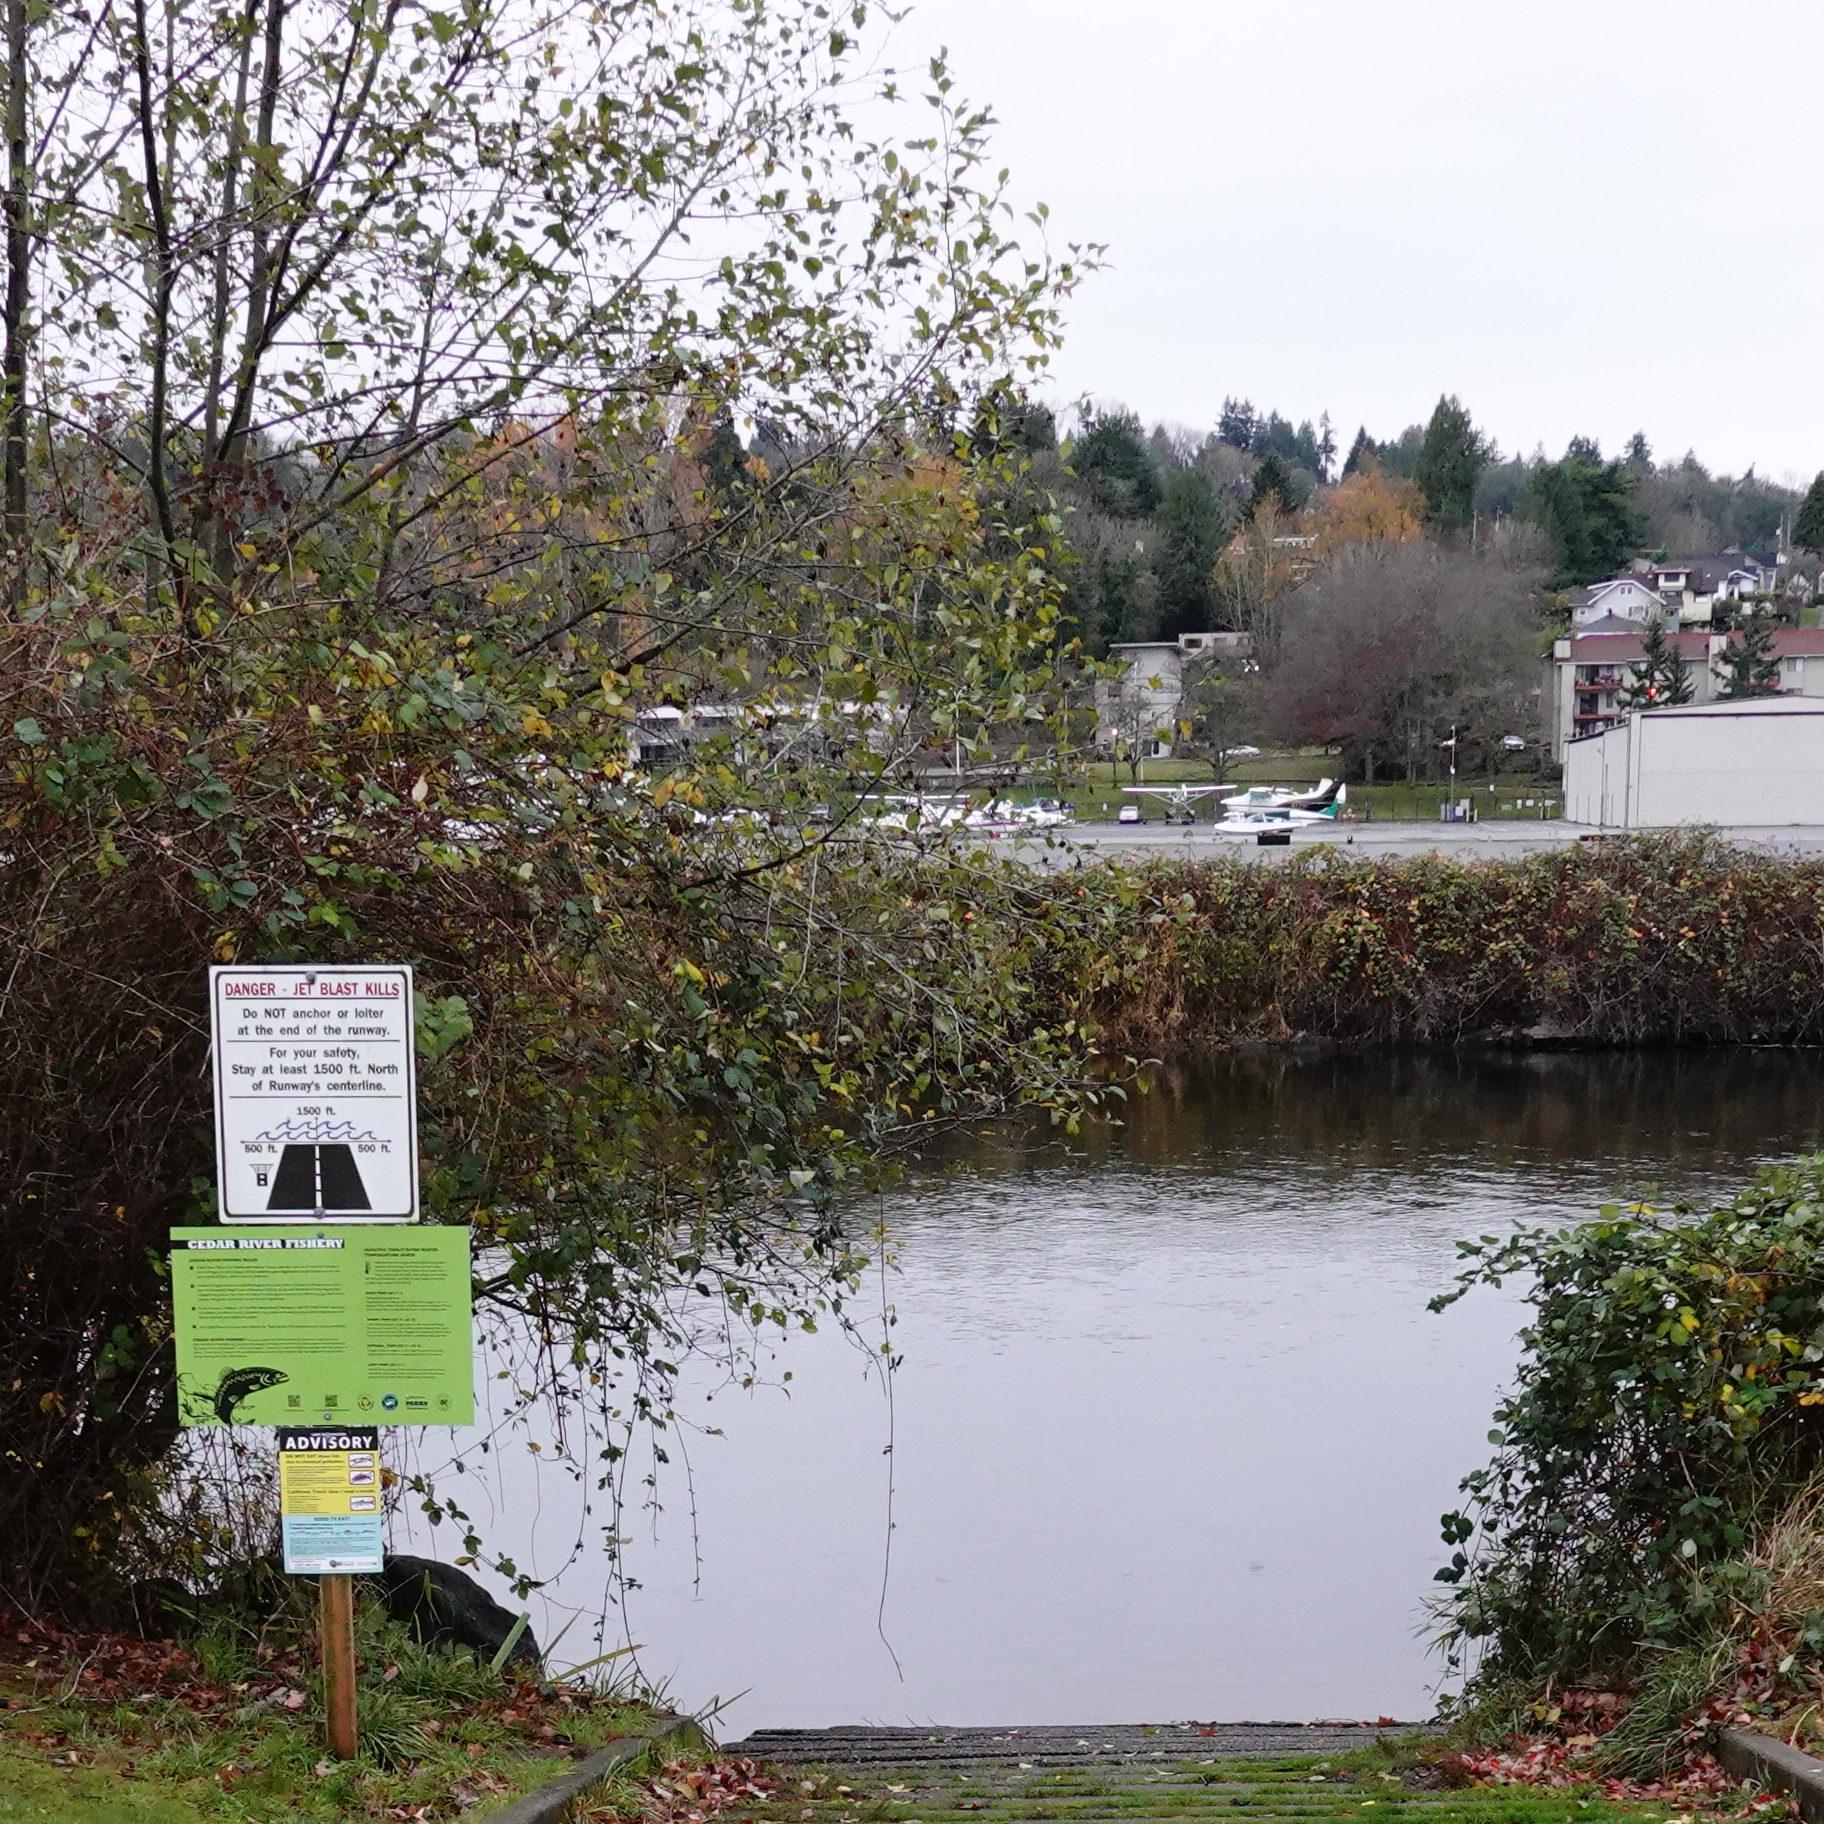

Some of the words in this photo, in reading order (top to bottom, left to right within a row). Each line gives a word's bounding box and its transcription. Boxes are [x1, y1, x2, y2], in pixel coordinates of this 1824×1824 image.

[225, 983, 275, 995] DANGER
[293, 983, 313, 995] JET
[320, 983, 358, 995] BLAST
[366, 983, 399, 996] KILLS
[243, 1009, 258, 1018] Do
[264, 1009, 286, 1018] NOT
[293, 1009, 331, 1018] anchor
[355, 1009, 383, 1018] loiter
[238, 1027, 249, 1035] at
[255, 1026, 273, 1035] the
[280, 1026, 299, 1035] end
[307, 1026, 317, 1035] of
[323, 1026, 341, 1035] the
[348, 1027, 390, 1037] runway.
[270, 1048, 287, 1058] For
[293, 1050, 317, 1060] your
[323, 1048, 360, 1060] safety,
[232, 1065, 255, 1076] Stay
[262, 1066, 274, 1074] at
[280, 1065, 307, 1074] least
[314, 1065, 342, 1074] 1500
[349, 1065, 361, 1074] ft.
[368, 1065, 397, 1074] North
[252, 1081, 262, 1091] of
[269, 1081, 320, 1093] Runway's
[327, 1081, 385, 1091] centerline.
[297, 1107, 321, 1115] 1500
[326, 1107, 336, 1115] ft.
[245, 1145, 262, 1153] 500
[268, 1145, 278, 1153] ft.
[358, 1145, 376, 1153] 500
[381, 1145, 390, 1153] ft.
[187, 1240, 235, 1250] CEDAR
[238, 1240, 282, 1249] RIVER
[285, 1239, 343, 1249] FISHERY
[286, 1436, 372, 1449] ADVISORY
